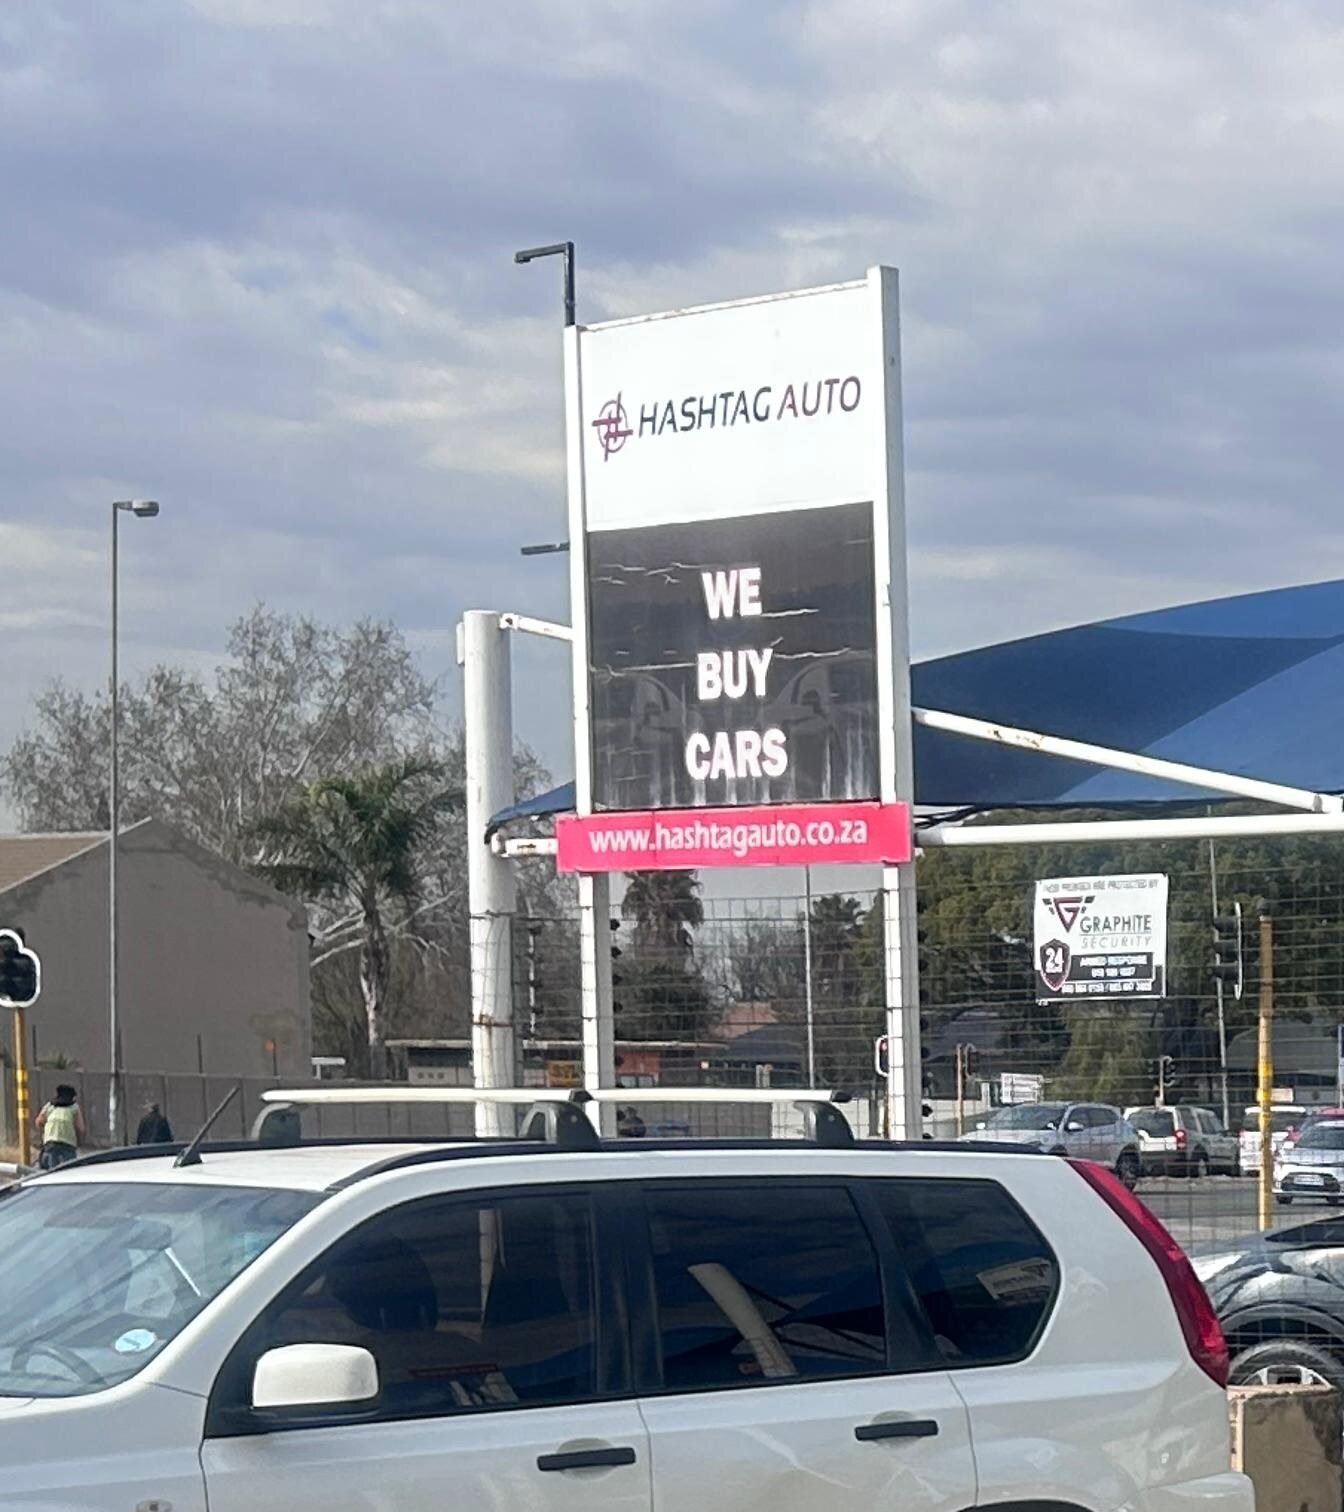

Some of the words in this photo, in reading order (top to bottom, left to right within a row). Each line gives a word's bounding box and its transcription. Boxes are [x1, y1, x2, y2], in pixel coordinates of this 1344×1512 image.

[638, 386, 771, 438] HASHTAG
[777, 376, 861, 420] AUTO
[702, 567, 762, 619] WE
[697, 648, 773, 700] BUY
[685, 728, 788, 780] CARS
[589, 820, 867, 857] www.hashtagauto.co.za
[1080, 915, 1152, 933] GRAPHITE
[1081, 935, 1152, 949] SECURITY
[1045, 947, 1064, 967] 24
